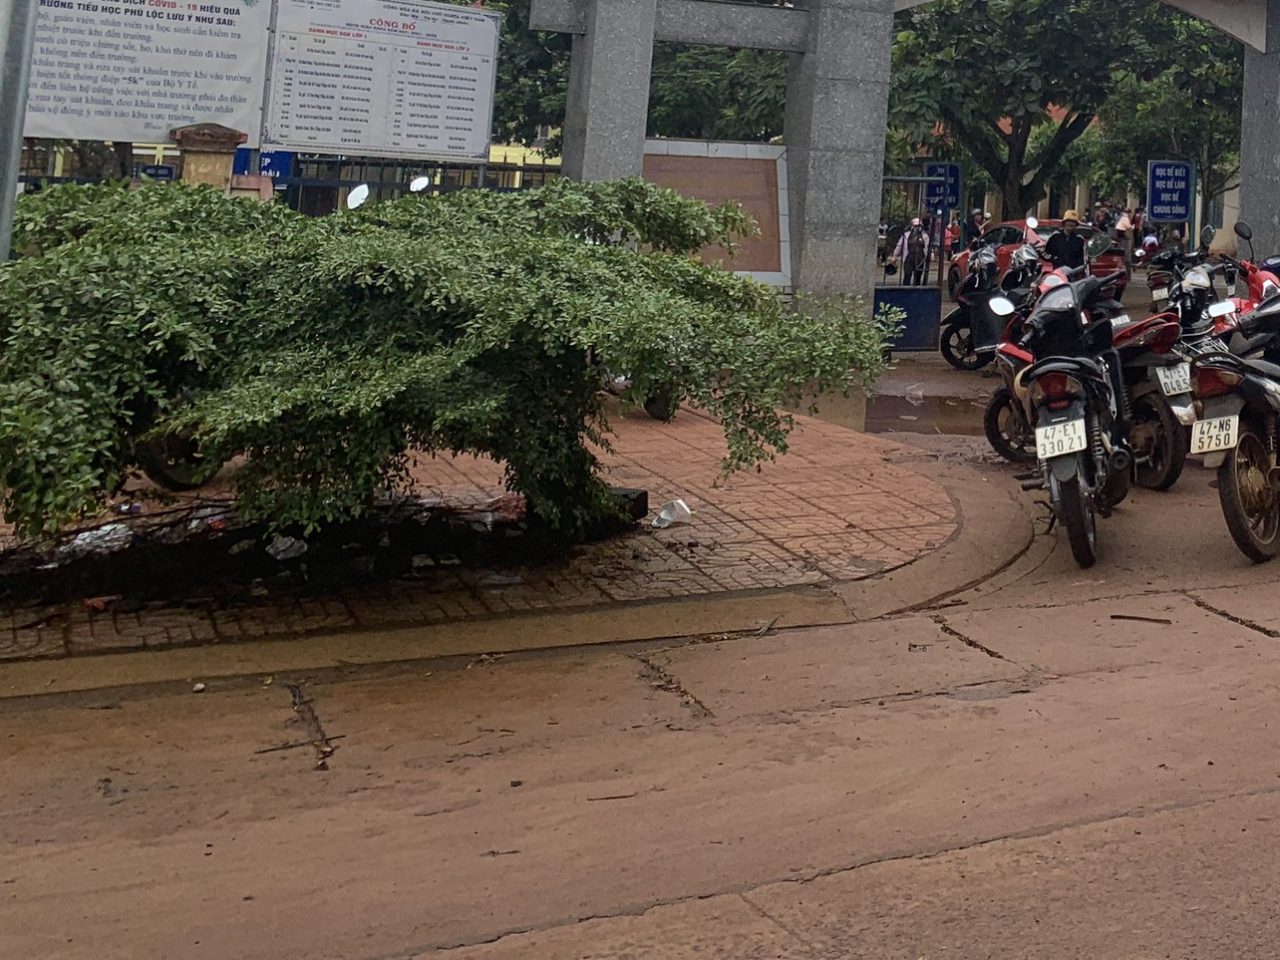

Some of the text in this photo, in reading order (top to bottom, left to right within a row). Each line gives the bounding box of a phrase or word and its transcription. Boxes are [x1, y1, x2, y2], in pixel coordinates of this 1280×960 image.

[40, 0, 74, 9] RƯỜNG
[77, 1, 98, 12] TIỂU
[101, 5, 121, 15] HỌC
[124, 7, 143, 17] PHÚ
[146, 10, 164, 19] LỘC
[167, 13, 184, 21] LƯU
[195, 16, 214, 24] NHƯ
[216, 18, 236, 27] SAU:
[148, 0, 176, 9] COVID
[187, 3, 197, 11] 19
[200, 4, 220, 14] HIỆU
[223, 6, 240, 16] QUẢ
[369, 16, 399, 29] CÔNG
[402, 21, 417, 31] BỐ
[1162, 365, 1187, 379] 47-E1
[1163, 378, 1190, 394] 048.5
[1043, 421, 1077, 439] 47-E1
[1199, 419, 1232, 433] 47-N6
[1040, 434, 1084, 456] 330.21
[1198, 431, 1230, 449] 5750
